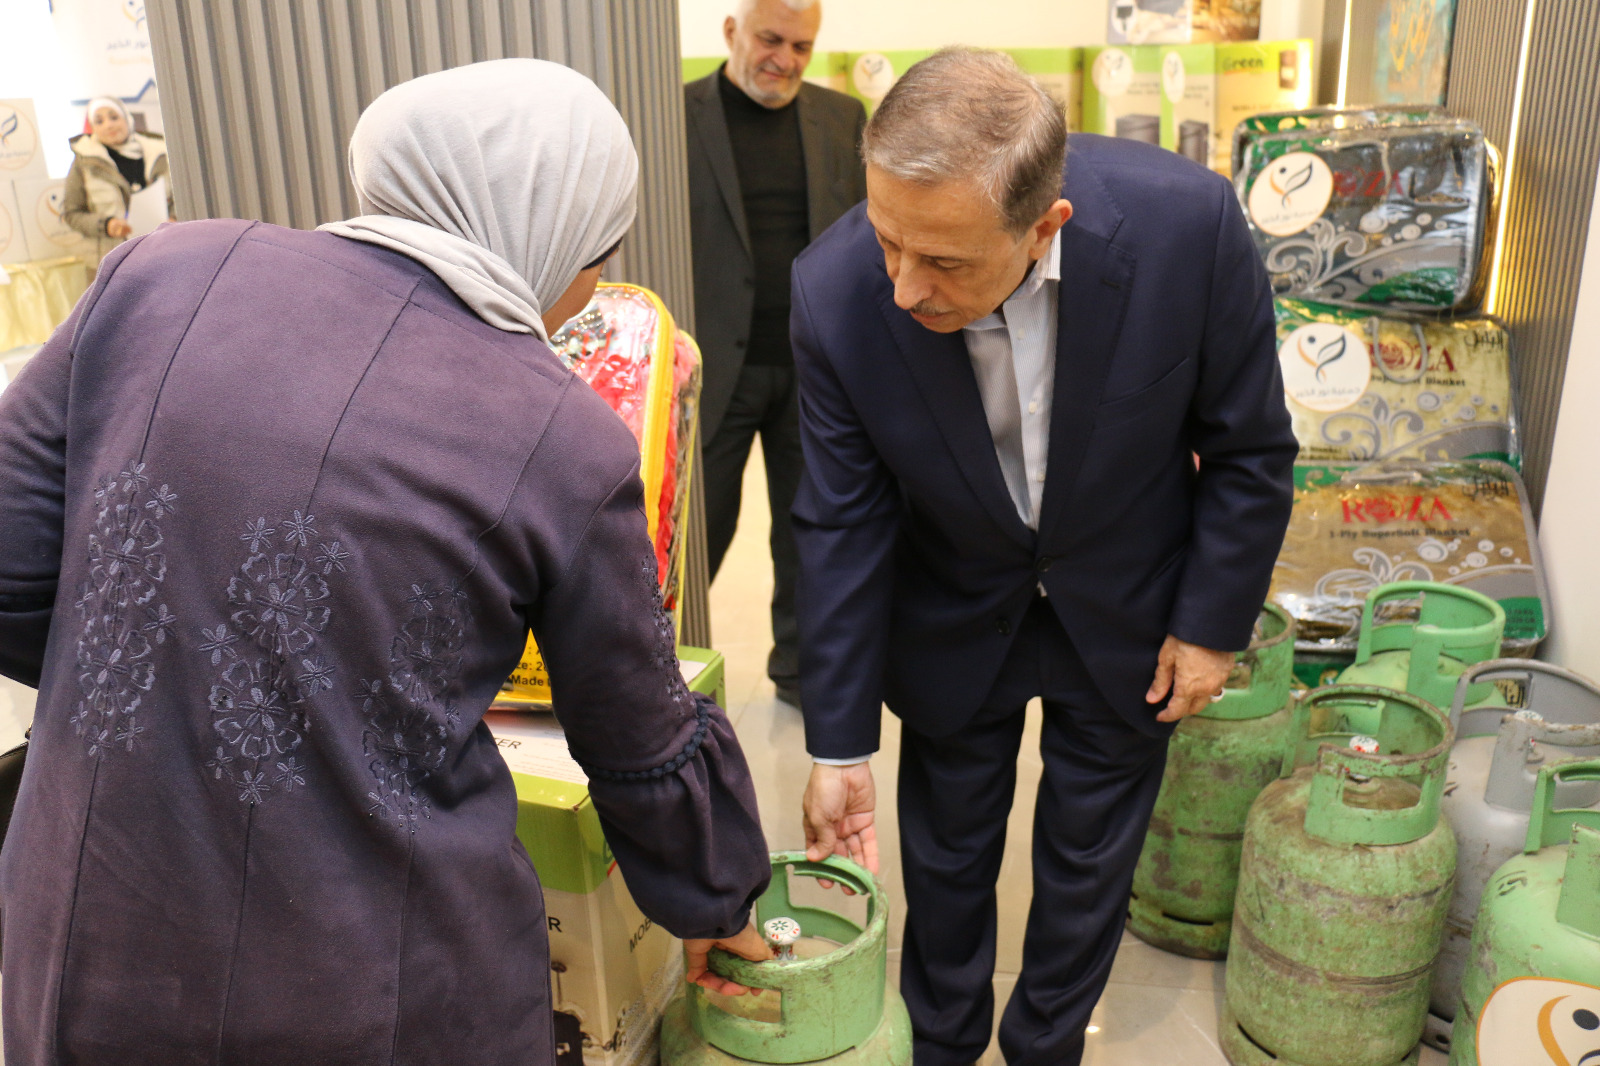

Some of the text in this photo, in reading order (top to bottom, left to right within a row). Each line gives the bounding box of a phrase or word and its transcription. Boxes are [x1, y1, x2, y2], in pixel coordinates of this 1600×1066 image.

[1334, 167, 1405, 196] OZA
[1341, 492, 1453, 524] ROZA
[1425, 527, 1471, 537] Blanket
[510, 674, 544, 687] Made
